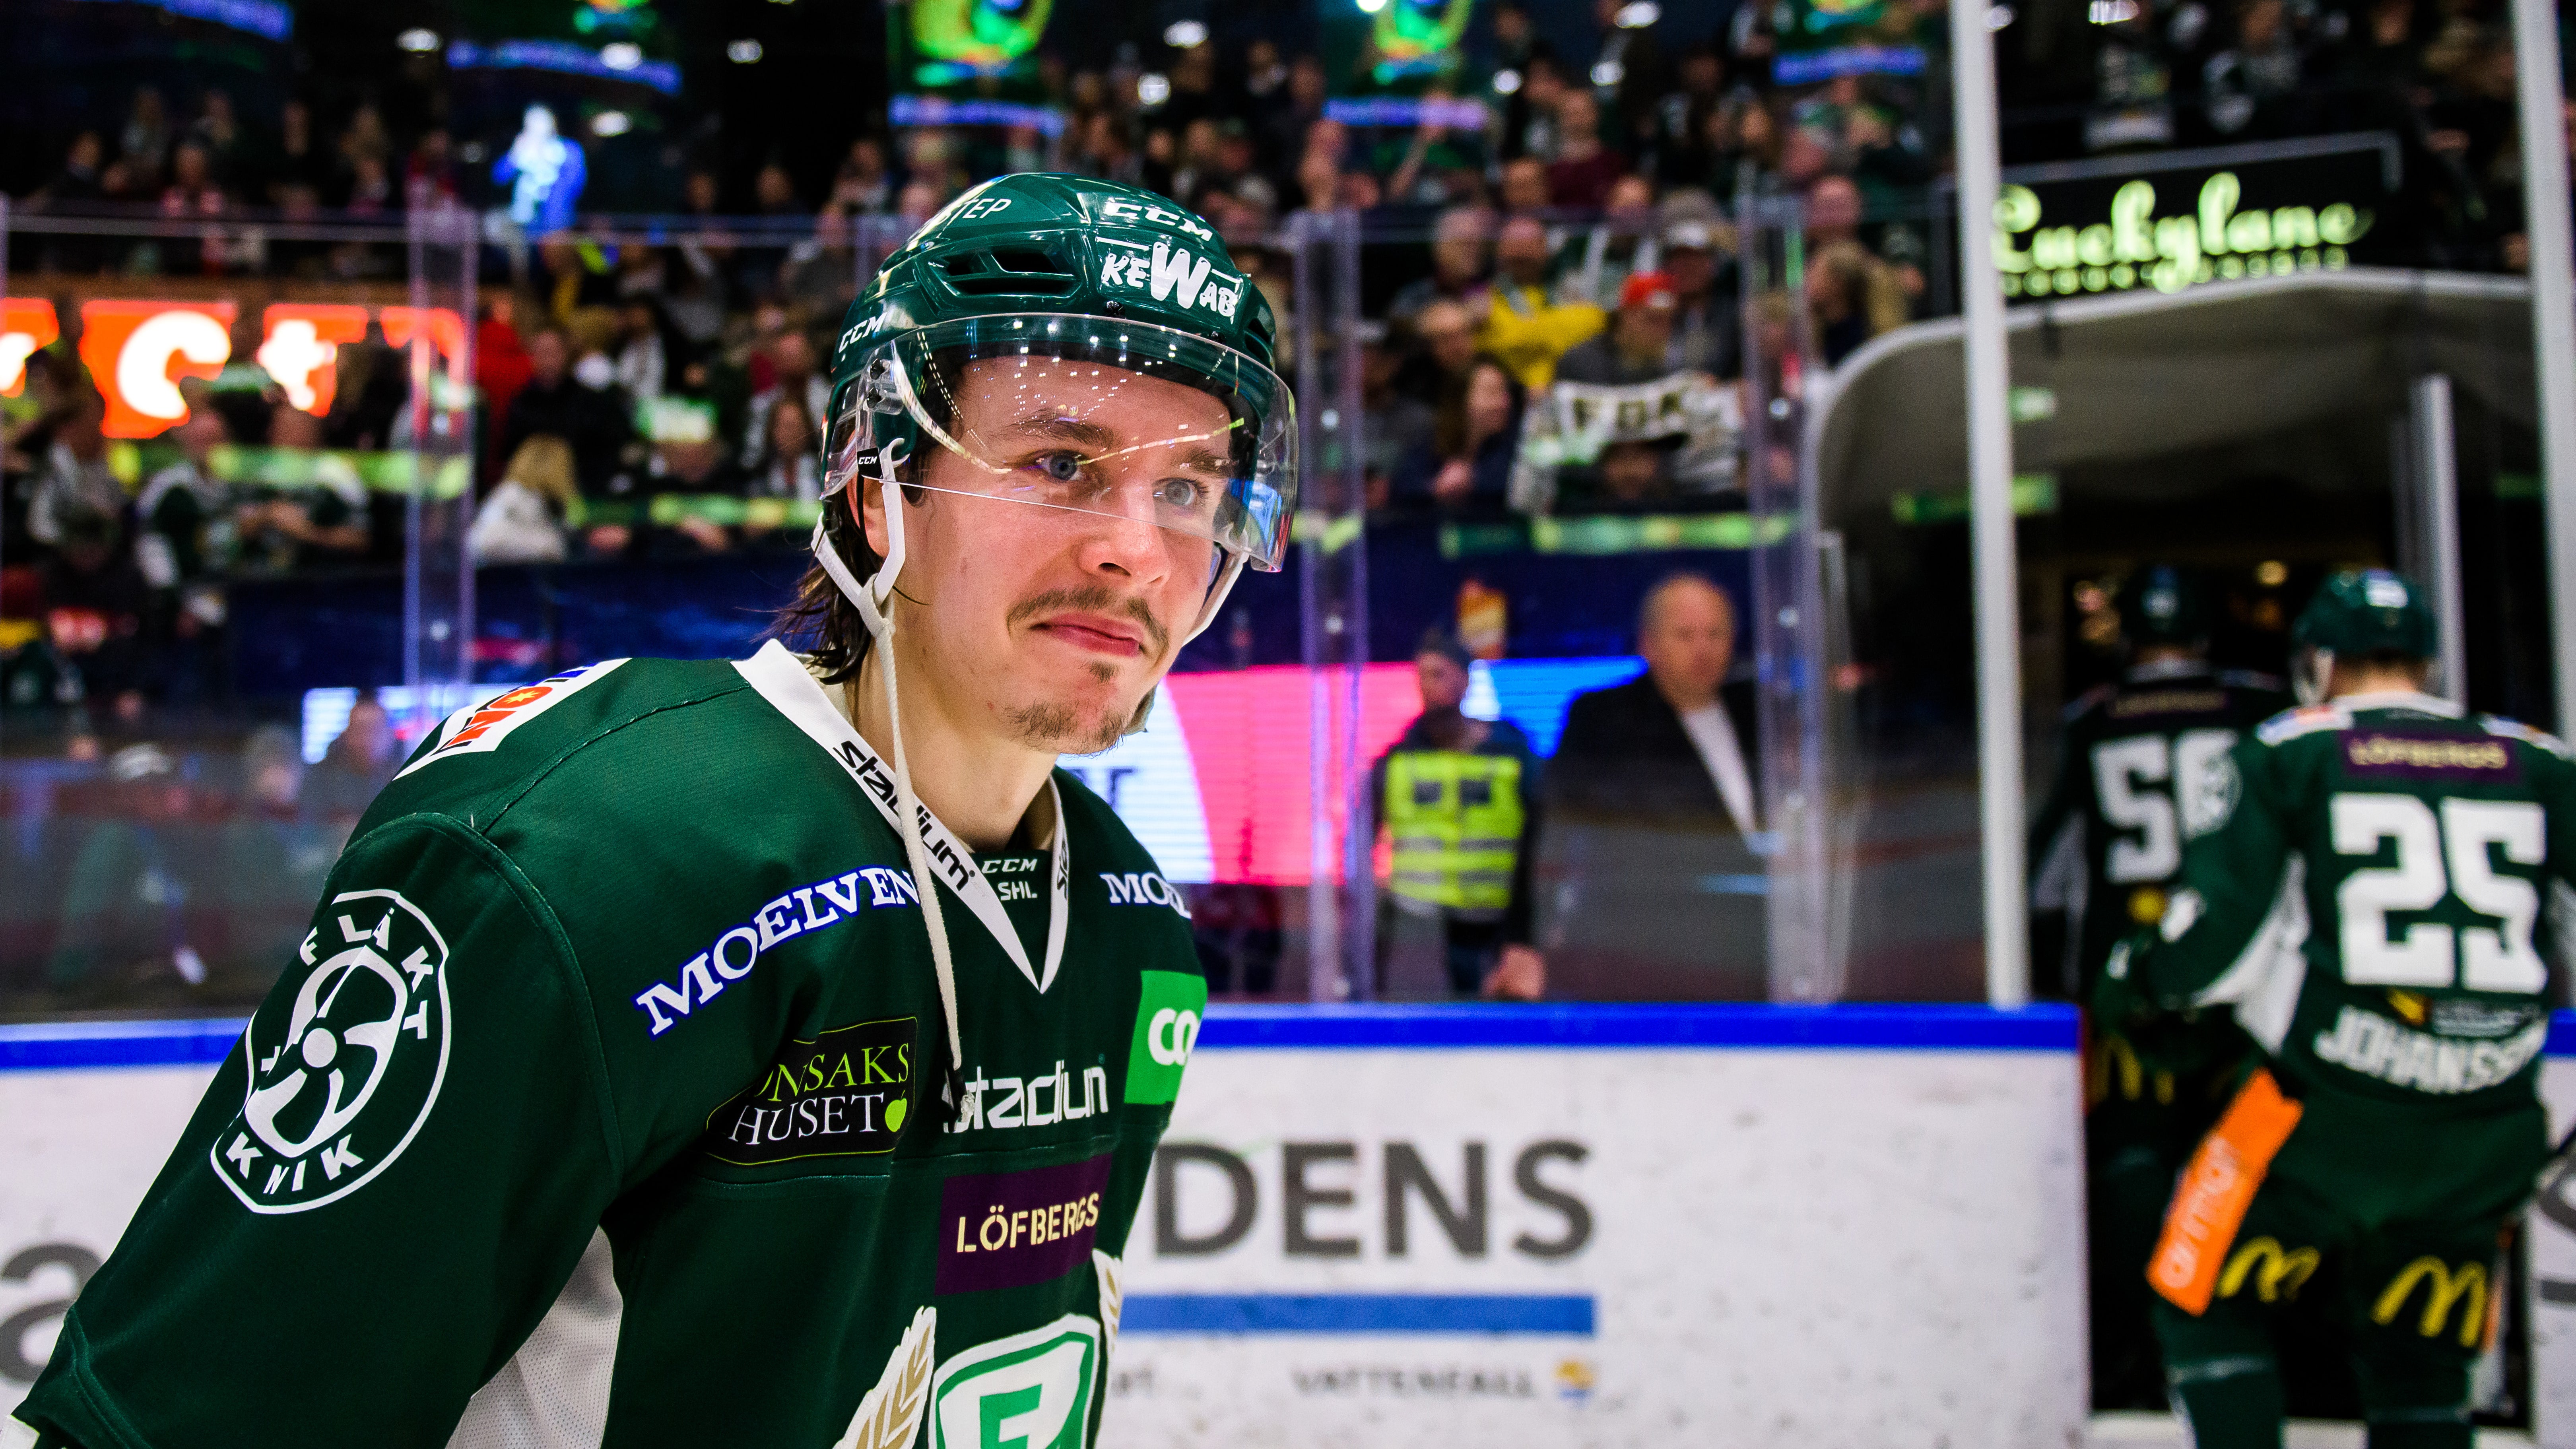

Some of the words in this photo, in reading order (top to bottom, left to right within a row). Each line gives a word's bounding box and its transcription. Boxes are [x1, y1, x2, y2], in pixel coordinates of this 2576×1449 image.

[1105, 199, 1213, 241] CCM
[839, 312, 887, 353] CCM
[858, 456, 877, 465] CCM
[982, 859, 1037, 873] CCM
[998, 881, 1037, 901] SHL
[2329, 792, 2547, 993] 25
[634, 865, 921, 1038] MOELVEN
[728, 1092, 884, 1145] HUSET
[957, 1193, 1099, 1252] LÖFBERGS
